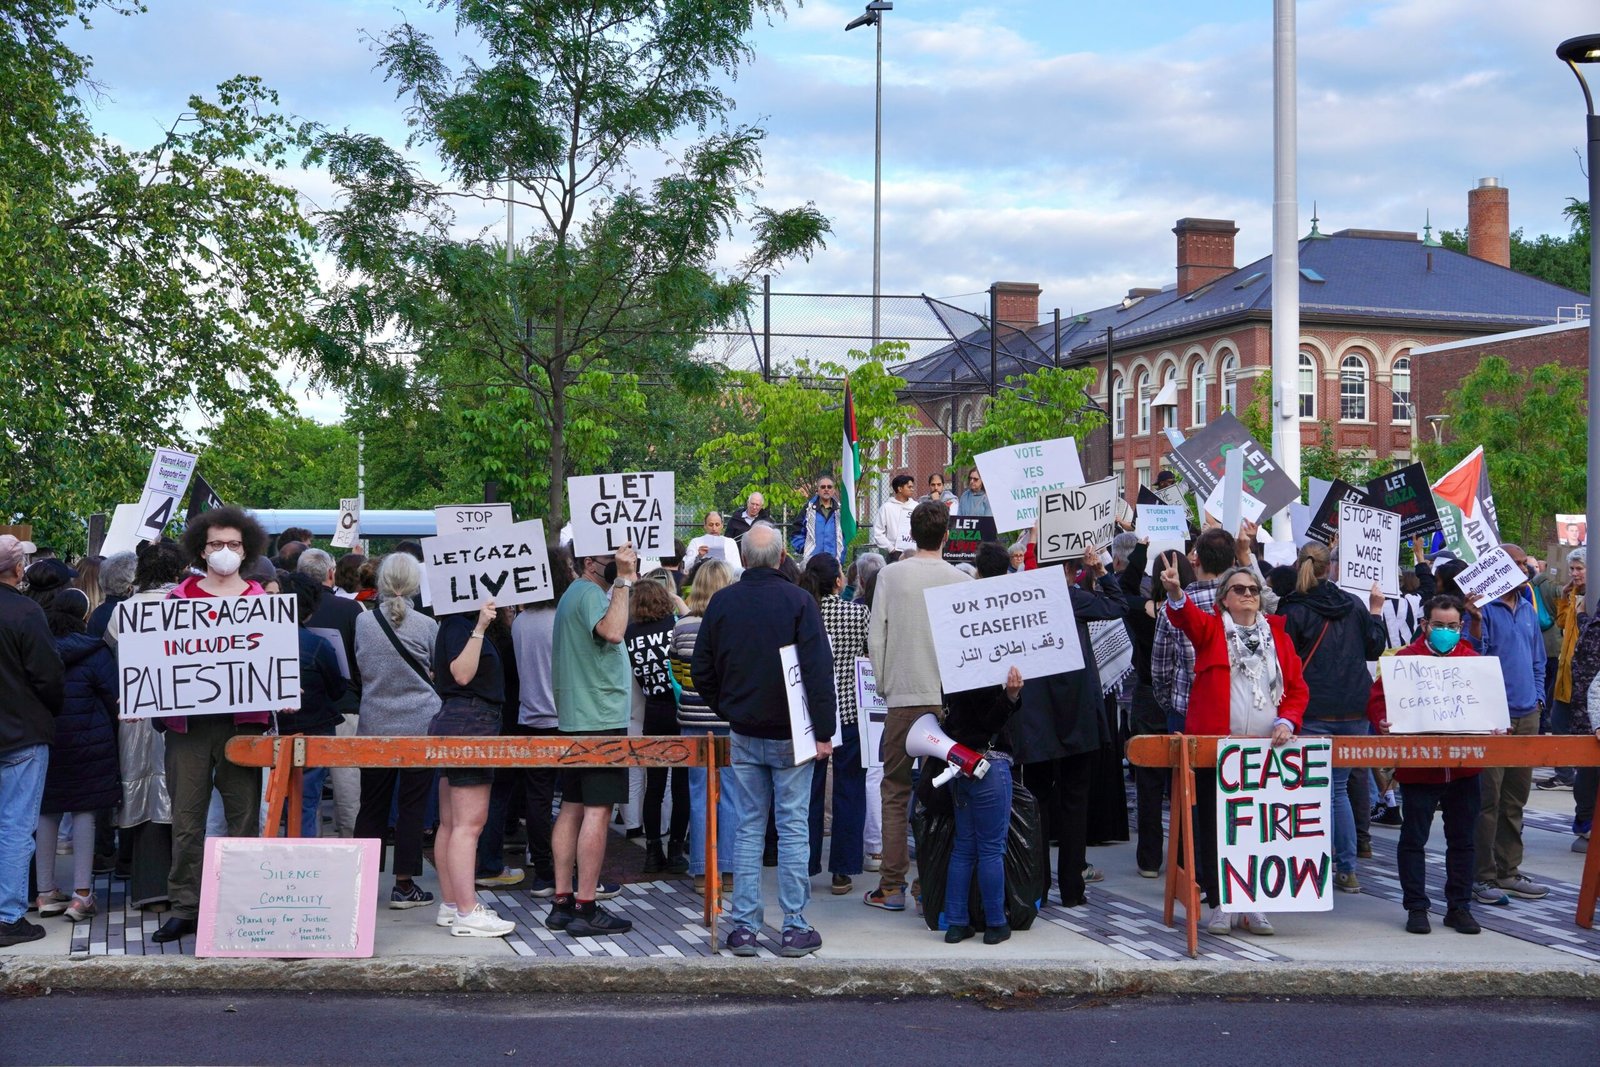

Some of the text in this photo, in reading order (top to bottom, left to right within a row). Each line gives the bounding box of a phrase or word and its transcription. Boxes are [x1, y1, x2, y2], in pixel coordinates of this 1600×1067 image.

[1014, 445, 1043, 459] VOTE
[1236, 440, 1275, 475] LET
[1023, 466, 1044, 478] YES
[1385, 473, 1406, 492] LET
[599, 474, 654, 500] LET
[1343, 489, 1364, 503] LET
[590, 498, 662, 525] GAZA
[1045, 490, 1087, 513] END
[1089, 500, 1111, 521] THE
[145, 496, 174, 533] 4
[456, 511, 493, 523] STOP
[955, 519, 979, 529] LET
[1343, 506, 1373, 525] STOP
[1377, 512, 1393, 530] THE
[1437, 505, 1458, 545] FREE
[606, 525, 660, 551] LIVE
[949, 529, 982, 541] GAZA
[1363, 527, 1382, 542] WAR
[433, 543, 532, 566] LET GAZA
[1356, 544, 1383, 563] WAGE
[1347, 562, 1384, 586] PEACE!
[1457, 565, 1480, 586] Warrant
[1478, 554, 1499, 574] Article
[1496, 549, 1506, 561] 19
[1469, 563, 1513, 596] Supporter From
[1487, 581, 1513, 599] Precinct
[952, 588, 1046, 614] הפסקת אש
[119, 597, 295, 633] NEVER AGAIN
[959, 611, 1049, 638] CEASEFIRE
[164, 632, 264, 656] INCLUDES
[627, 630, 674, 652] JEWS
[633, 644, 671, 665] SAY
[956, 647, 982, 668] النار
[643, 671, 671, 685] FIR
[1393, 659, 1463, 680] ANOTHER
[123, 656, 298, 714] PALESTINE
[1452, 679, 1474, 689] FOR
[1399, 694, 1480, 709] CEASEFIRE
[425, 745, 532, 759] BROOKLINE
[1338, 746, 1486, 760] BROOKLINE DPW
[1218, 744, 1330, 794] CEASE
[1225, 797, 1325, 846] FIRE
[260, 861, 322, 880] SILENCE
[1221, 852, 1330, 904] NOW
[259, 892, 324, 906] COMPLICITY
[236, 914, 263, 926] Stand
[267, 917, 277, 926] up
[302, 913, 330, 923] Justice
[237, 928, 275, 938] Ceasefire
